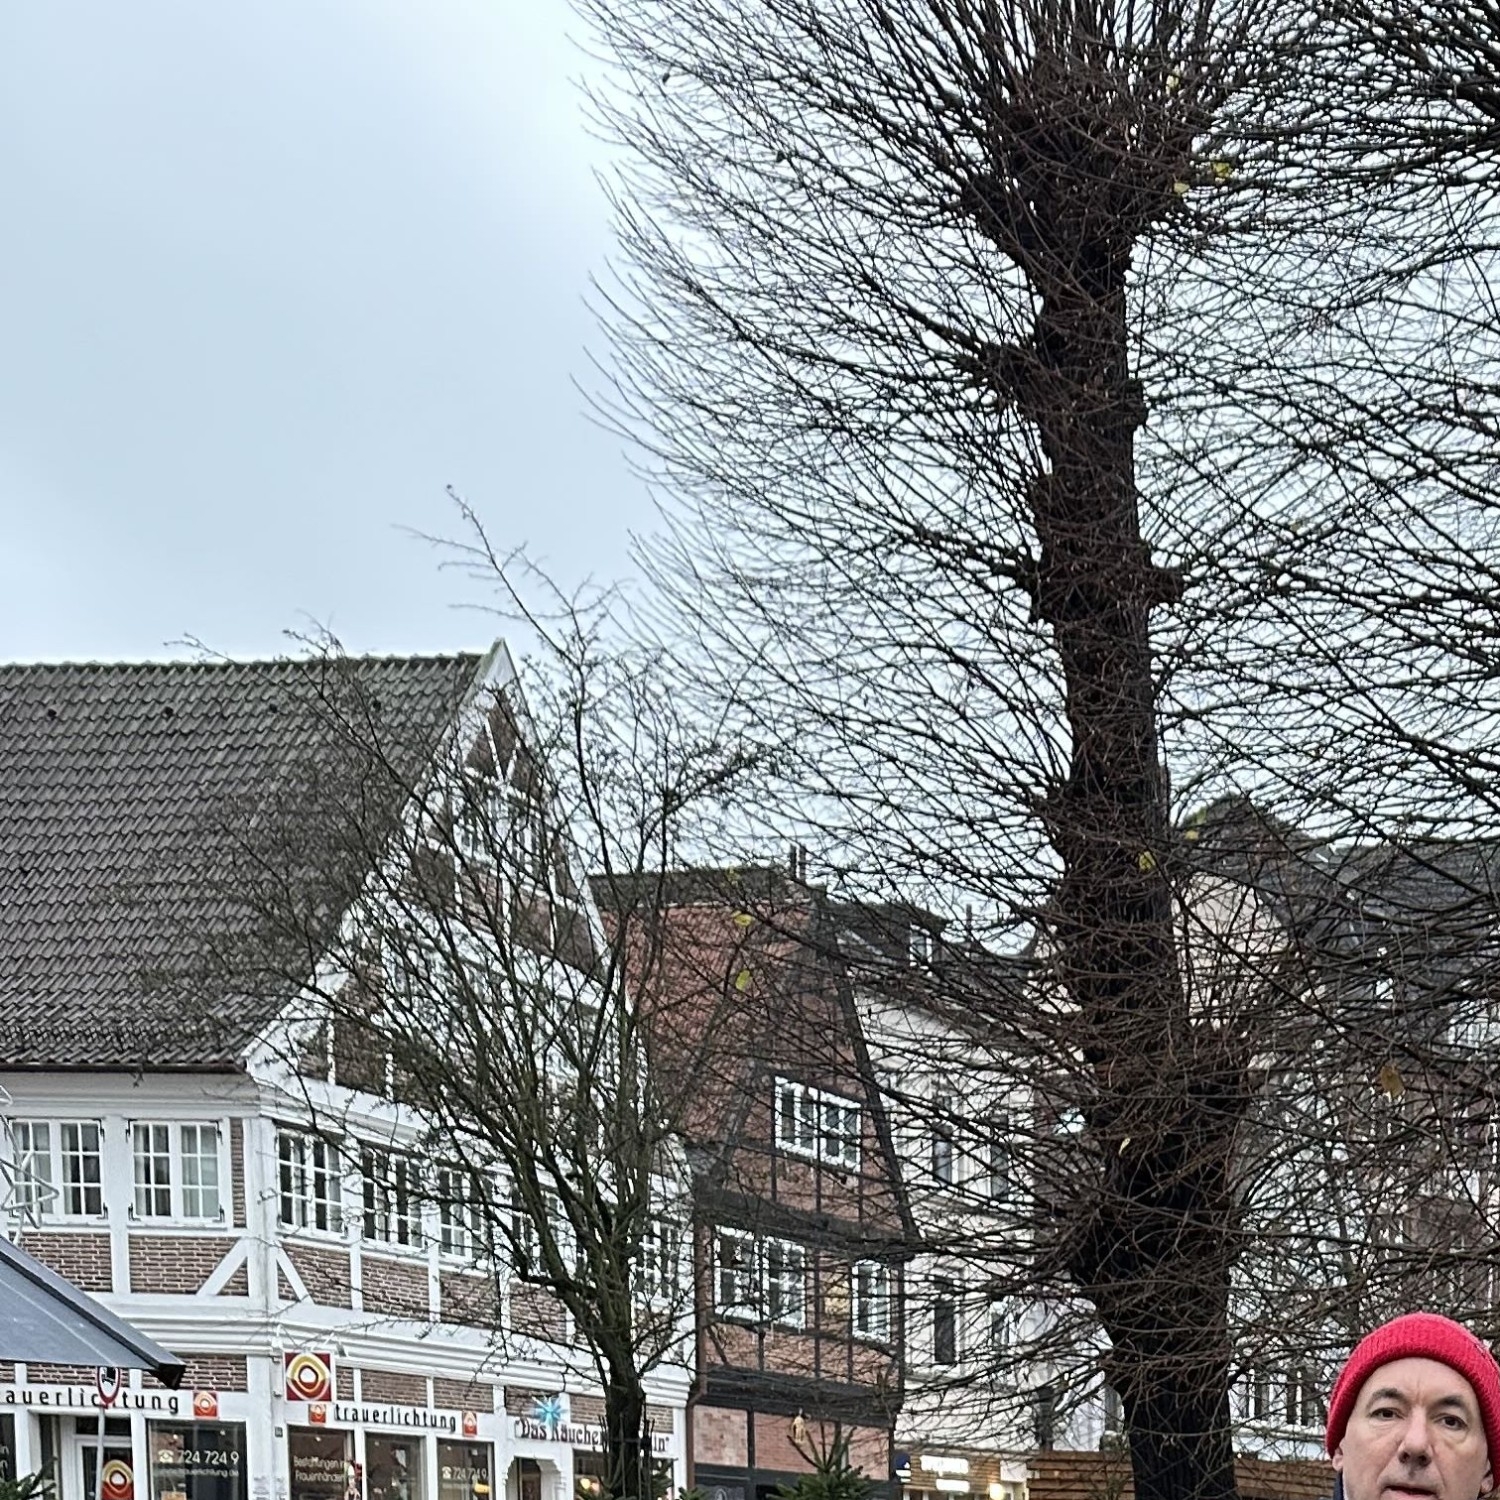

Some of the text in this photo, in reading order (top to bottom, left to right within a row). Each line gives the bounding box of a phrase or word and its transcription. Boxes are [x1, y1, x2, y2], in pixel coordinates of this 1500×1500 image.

[5, 1387, 179, 1414] auerlictung
[335, 1403, 457, 1433] trauerlichtung
[177, 1449, 240, 1465] 724 724 9
